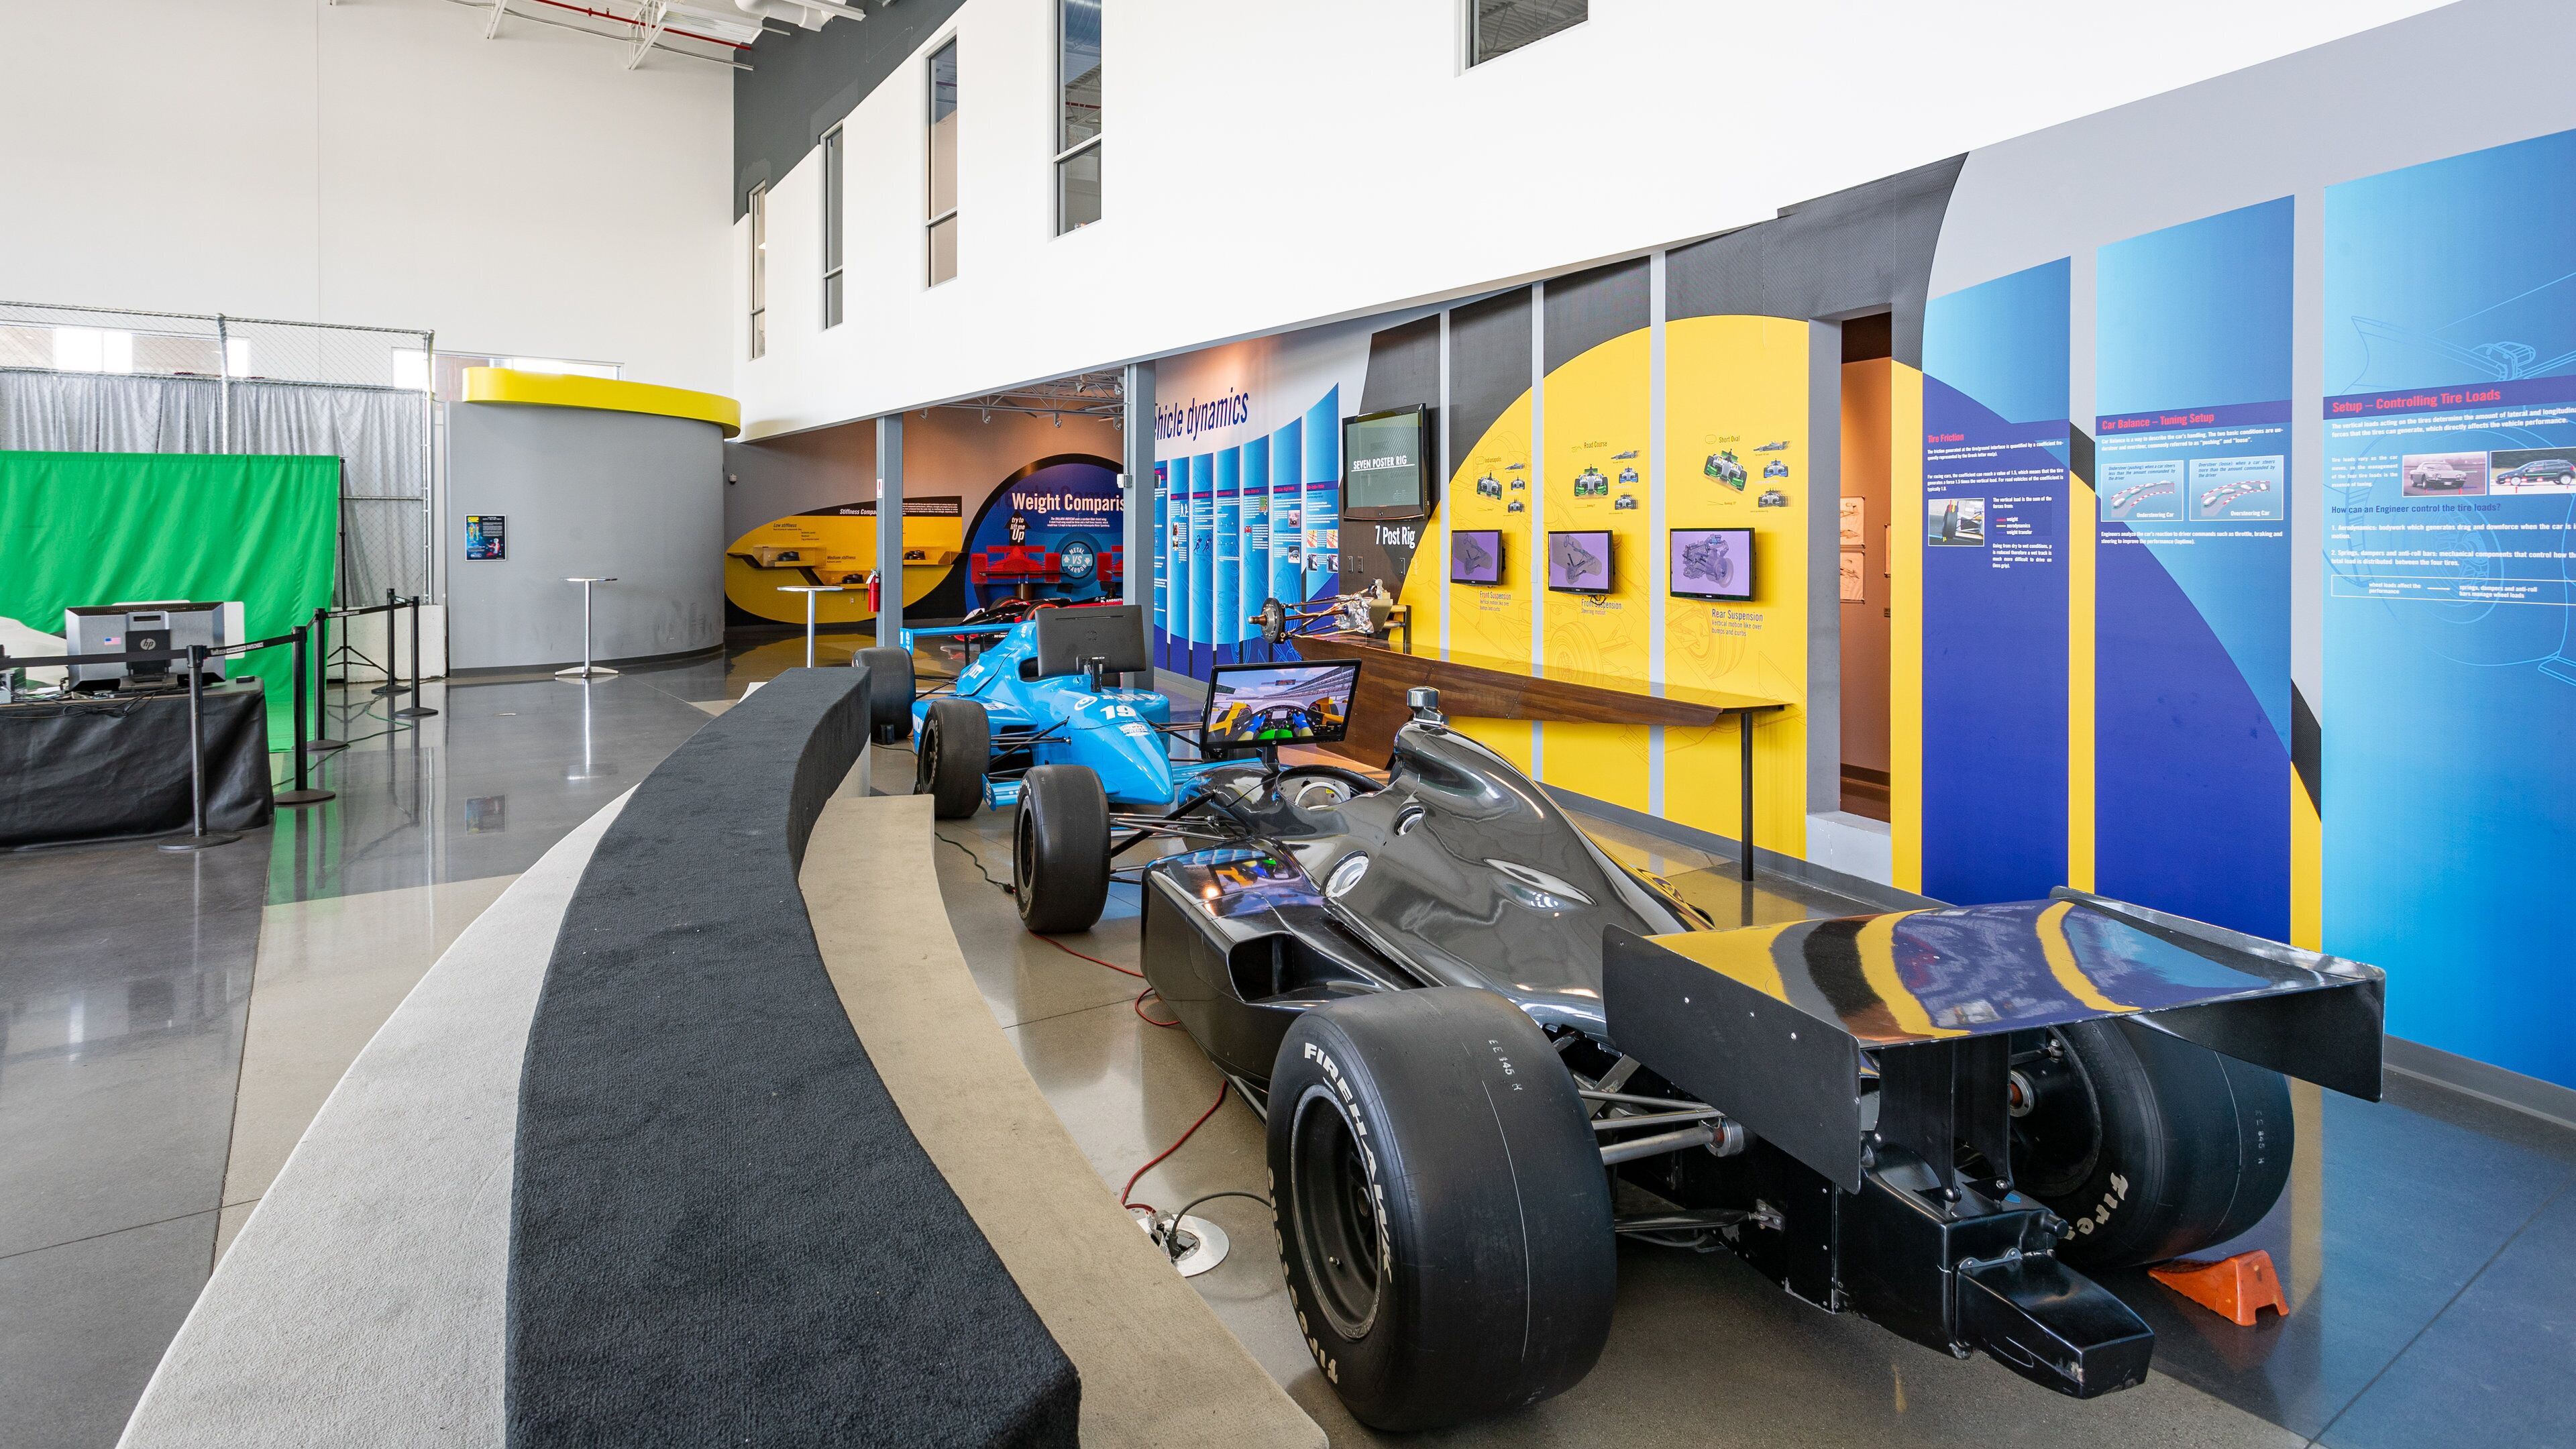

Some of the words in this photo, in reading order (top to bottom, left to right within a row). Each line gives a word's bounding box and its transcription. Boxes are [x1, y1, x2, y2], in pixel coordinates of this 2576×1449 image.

[2332, 402, 2362, 413] Setup
[2376, 395, 2437, 409] Controlling
[2440, 392, 2461, 404] Tire
[2466, 389, 2501, 402] Loads
[1155, 402, 1183, 440] hicle
[1187, 387, 1248, 441] dynamics
[2102, 420, 2115, 430] Car
[2118, 419, 2149, 429] Balance
[2160, 415, 2187, 426] Tuning
[2190, 413, 2214, 424] Setup
[2444, 423, 2467, 431] directly
[2525, 417, 2568, 426] performance.
[1940, 434, 1964, 442] Friction
[1353, 459, 1371, 470] SEVEN
[1373, 457, 1394, 468] POSTER
[1396, 455, 1407, 465] RIG
[1012, 493, 1060, 513] Weight
[2474, 503, 2501, 511] loads?
[1012, 529, 1024, 542] Up
[1375, 525, 1381, 545] 7
[1383, 527, 1400, 545] Post
[1402, 526, 1415, 549] Rig
[1072, 555, 1082, 564] VS
[1068, 564, 1087, 573] CARBON
[1491, 592, 1511, 600] Suspension
[1712, 608, 1726, 618] Rear
[1727, 610, 1763, 622] Suspension
[1100, 705, 1136, 720] 19
[1304, 1042, 1392, 1283] FIREHAWK
[1267, 1167, 1338, 1384] Firestone
